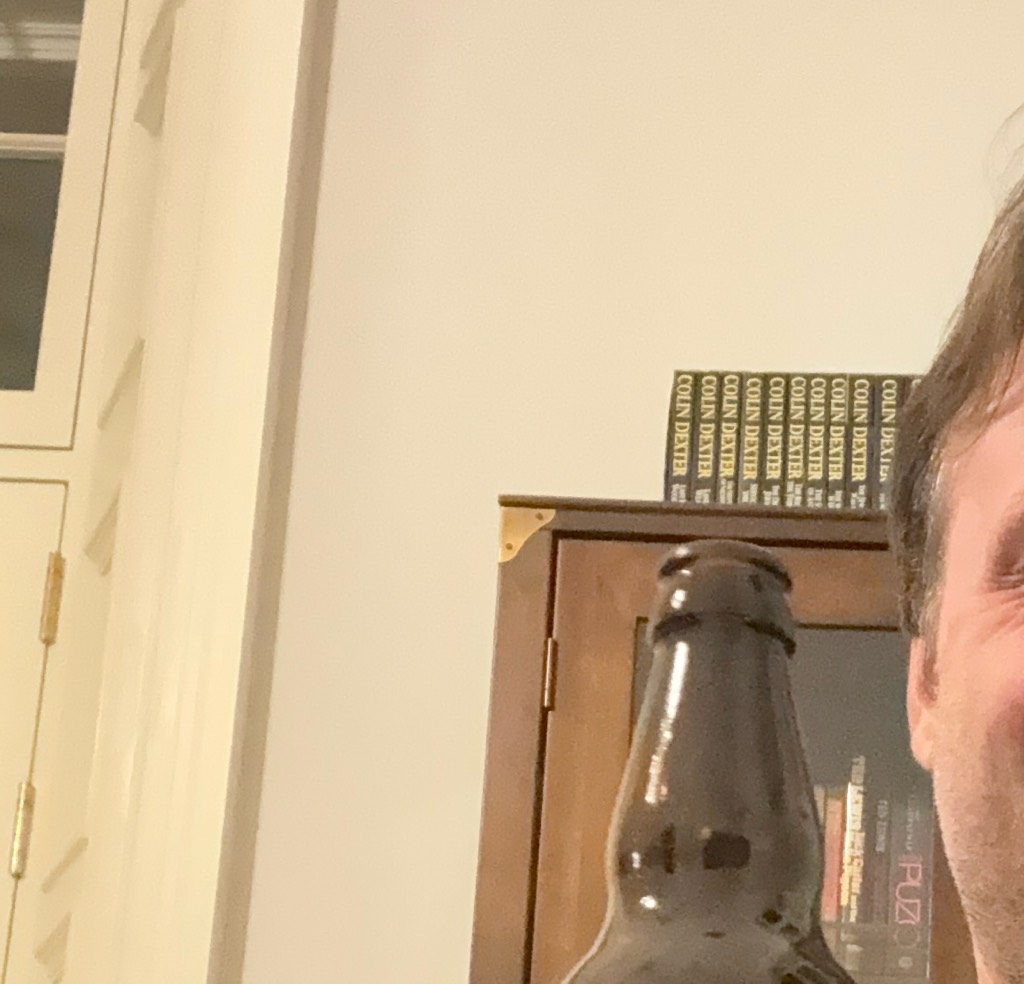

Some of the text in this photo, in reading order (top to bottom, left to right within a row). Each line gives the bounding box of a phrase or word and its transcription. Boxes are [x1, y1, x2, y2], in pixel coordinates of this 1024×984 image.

[676, 374, 692, 418] COLIN
[700, 375, 717, 419] COLIN
[722, 374, 739, 419] COLIN
[745, 377, 762, 421] COLIN
[767, 377, 785, 421] COLIN
[790, 376, 806, 420] COLIN
[810, 377, 826, 421] COLIN
[830, 378, 847, 422] COLIN
[853, 379, 869, 423] COLIN
[881, 379, 897, 424] COLIN
[672, 422, 690, 477] DEXTER
[697, 423, 715, 478] DEXTER
[719, 422, 737, 479] DEXTER
[743, 424, 760, 480] DEXTER
[765, 424, 783, 480] DEXTER
[787, 424, 805, 479] DEXTER
[807, 425, 824, 480] DEXTER
[828, 425, 845, 481] DEXTER
[851, 426, 867, 481] DEXTER
